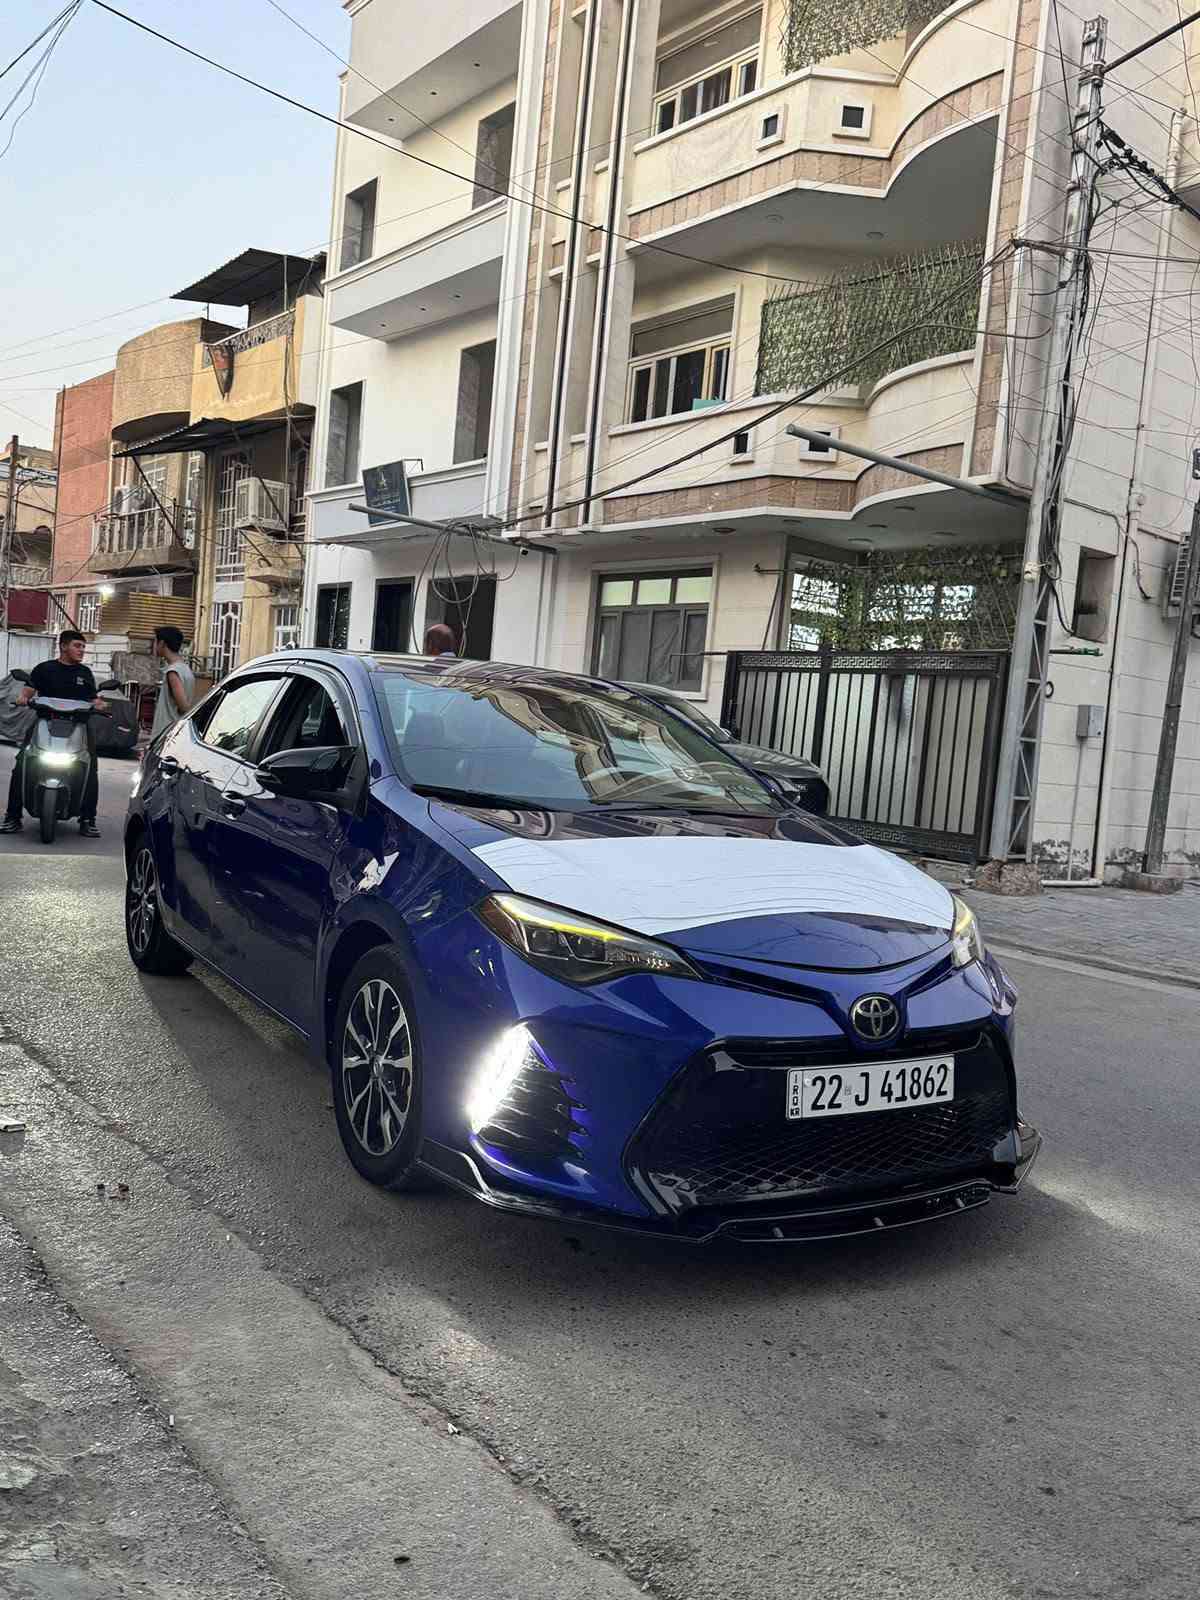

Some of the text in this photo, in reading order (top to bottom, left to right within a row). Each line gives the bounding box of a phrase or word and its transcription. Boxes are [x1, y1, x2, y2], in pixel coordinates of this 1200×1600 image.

[811, 1064, 948, 1111] 22 J 41862
